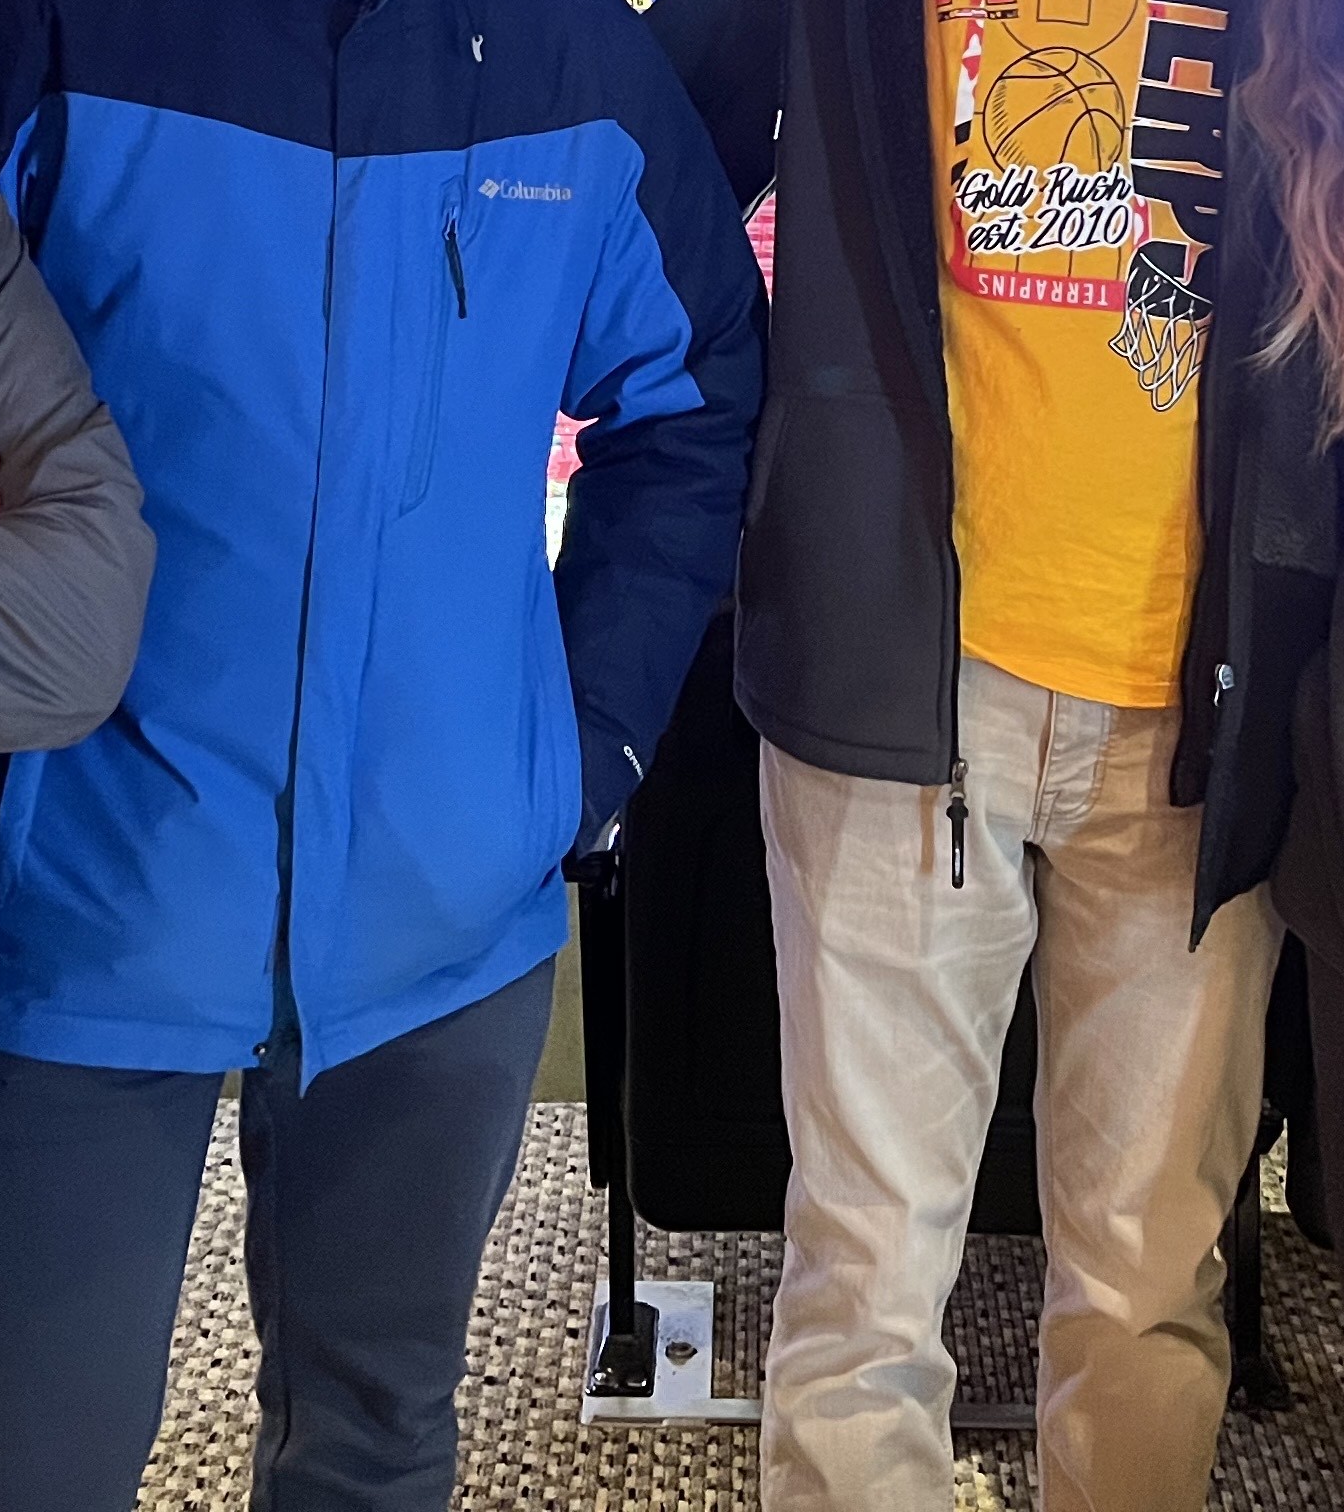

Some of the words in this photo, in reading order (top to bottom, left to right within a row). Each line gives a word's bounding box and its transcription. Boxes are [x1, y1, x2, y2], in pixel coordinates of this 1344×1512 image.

[500, 179, 572, 201] Columbia
[958, 168, 1035, 213] Gold
[1044, 166, 1133, 207] Rush
[967, 211, 1022, 252] est.
[1030, 204, 1129, 248] 2010
[977, 272, 1109, 307] TERRAPINS
